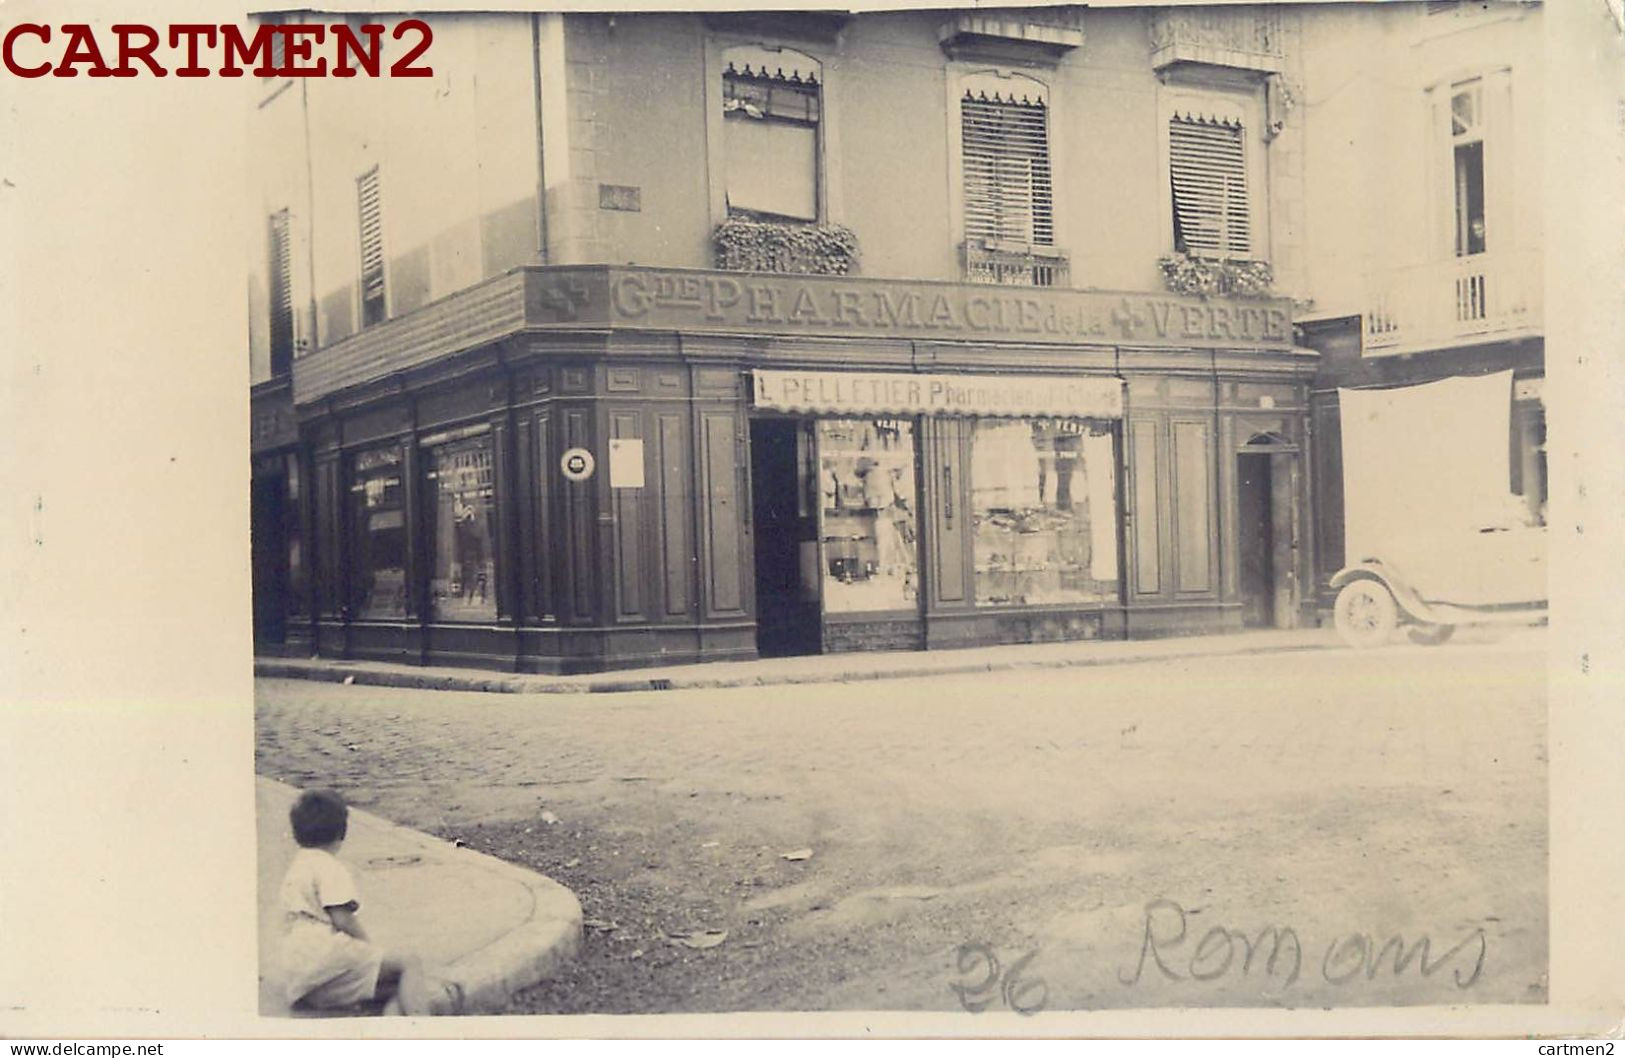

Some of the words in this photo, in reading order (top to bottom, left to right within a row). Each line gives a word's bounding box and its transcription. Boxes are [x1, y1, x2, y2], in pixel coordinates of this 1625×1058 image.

[703, 275, 1043, 334] PHARMACIE
[1145, 300, 1287, 341] VERTE
[782, 377, 921, 405] PELLETIER
[1117, 899, 1488, 990] Romans
